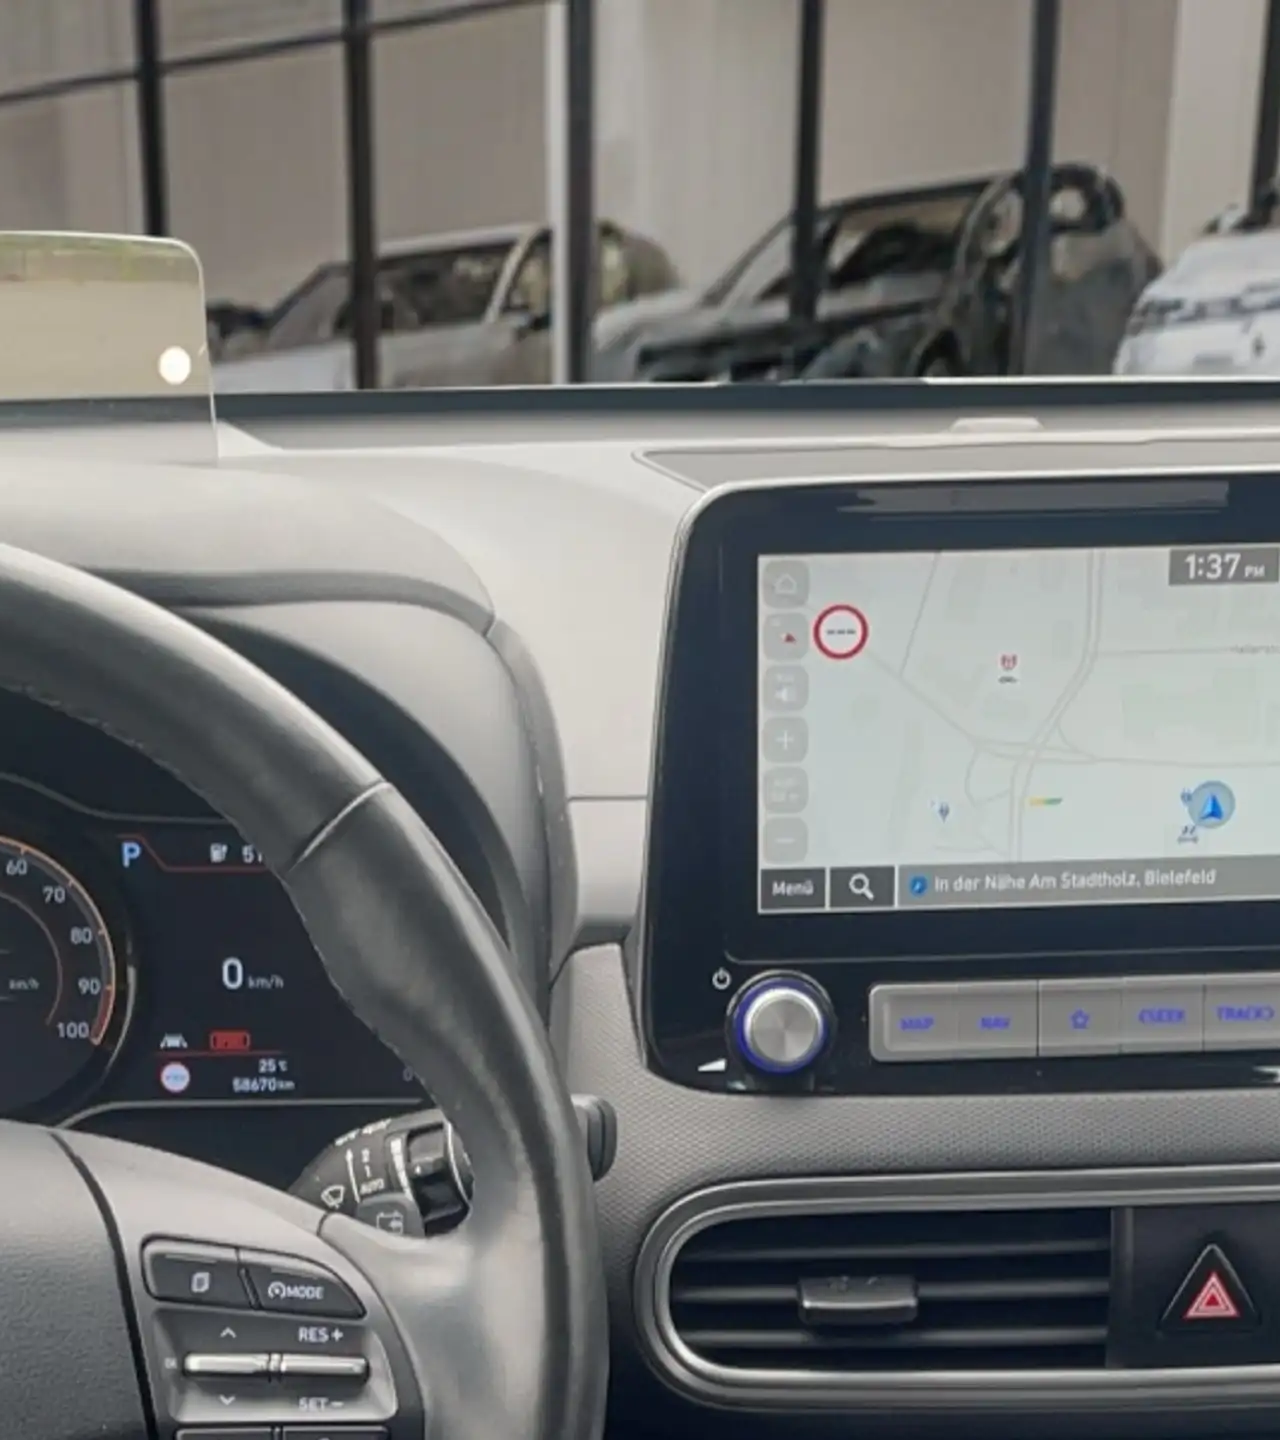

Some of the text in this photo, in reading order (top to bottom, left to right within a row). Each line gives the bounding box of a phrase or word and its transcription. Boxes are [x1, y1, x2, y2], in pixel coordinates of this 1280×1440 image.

[1185, 552, 1265, 580] 1:37 PM
[122, 841, 142, 868] P
[6, 858, 28, 876] 60
[772, 880, 813, 896] Menü
[953, 874, 980, 891] der
[984, 872, 1028, 890] Nähe
[1030, 872, 1057, 889] Am
[1060, 869, 1140, 890] Stadtholz,
[1145, 868, 1217, 886] Bielefeld
[43, 886, 66, 904] 70
[70, 927, 93, 945] 80
[222, 958, 284, 990] 0 km/h
[78, 978, 100, 995] 90
[57, 1022, 89, 1040] 100
[286, 1284, 325, 1299] MODE
